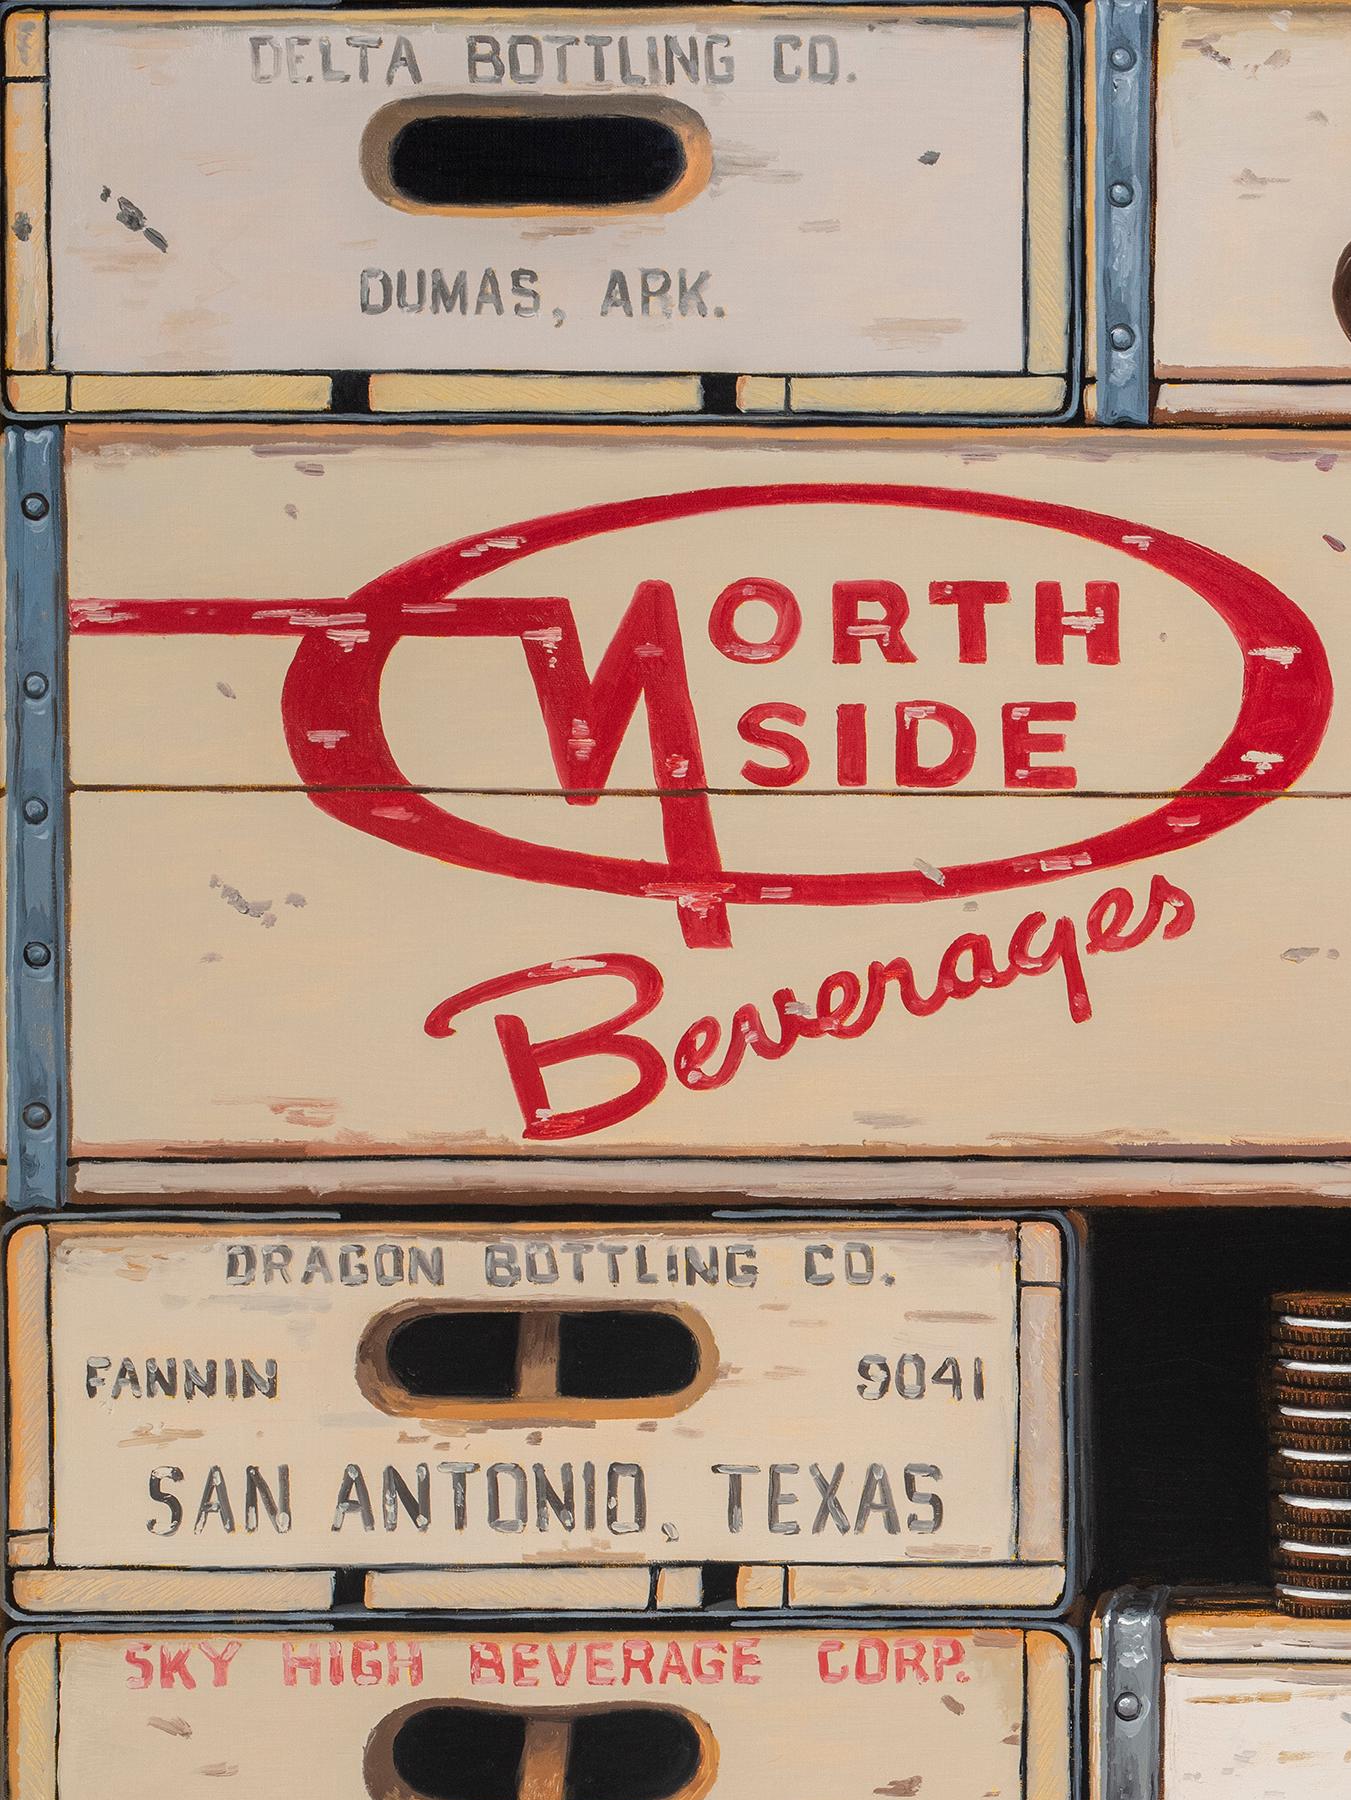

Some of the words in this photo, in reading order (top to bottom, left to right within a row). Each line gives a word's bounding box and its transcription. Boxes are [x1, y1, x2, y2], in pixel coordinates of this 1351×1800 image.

[249, 34, 424, 86] DELTA
[467, 34, 735, 86] BOTTLING
[773, 34, 857, 86] CO.
[359, 267, 567, 328] DUMAS,
[600, 268, 727, 320] ARK.
[738, 700, 1078, 789] SIDE
[422, 874, 1196, 1141] Beverages
[225, 1243, 445, 1288] DRAGON
[484, 1242, 760, 1288] BOTTLING
[803, 1243, 897, 1287] CO.
[85, 1355, 279, 1401] FANNIN
[855, 1352, 988, 1402] 9041
[144, 1463, 291, 1537] SAN
[709, 1462, 945, 1536] TEXAS
[124, 1639, 243, 1690] SKY
[280, 1639, 425, 1688] HIGH
[469, 1638, 763, 1687] BEVERAGE
[816, 1637, 972, 1686] CORP.
